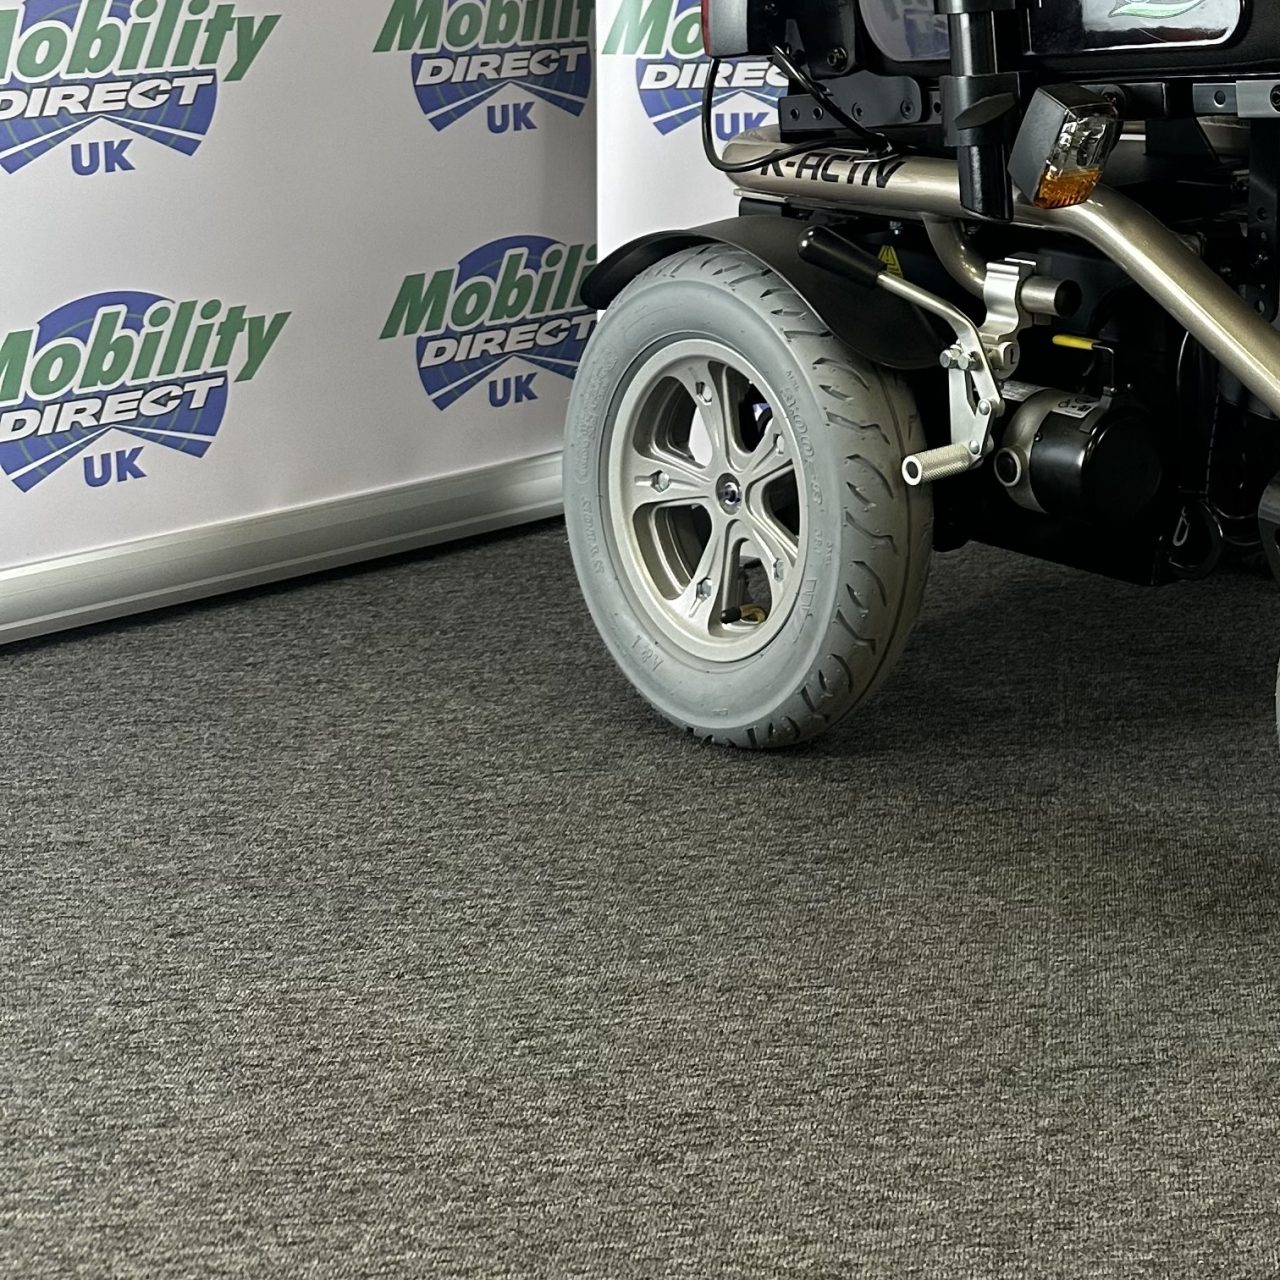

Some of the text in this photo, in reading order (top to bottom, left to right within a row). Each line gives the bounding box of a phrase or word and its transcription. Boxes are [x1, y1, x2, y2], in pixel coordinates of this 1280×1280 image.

[415, 47, 588, 87] DIRECT
[486, 102, 538, 135] UK
[714, 111, 769, 142] UK
[71, 138, 136, 176] UK
[419, 314, 597, 369] DIRECT
[488, 372, 539, 408] UK
[0, 377, 225, 443] DIRECT
[83, 446, 147, 488] UK
